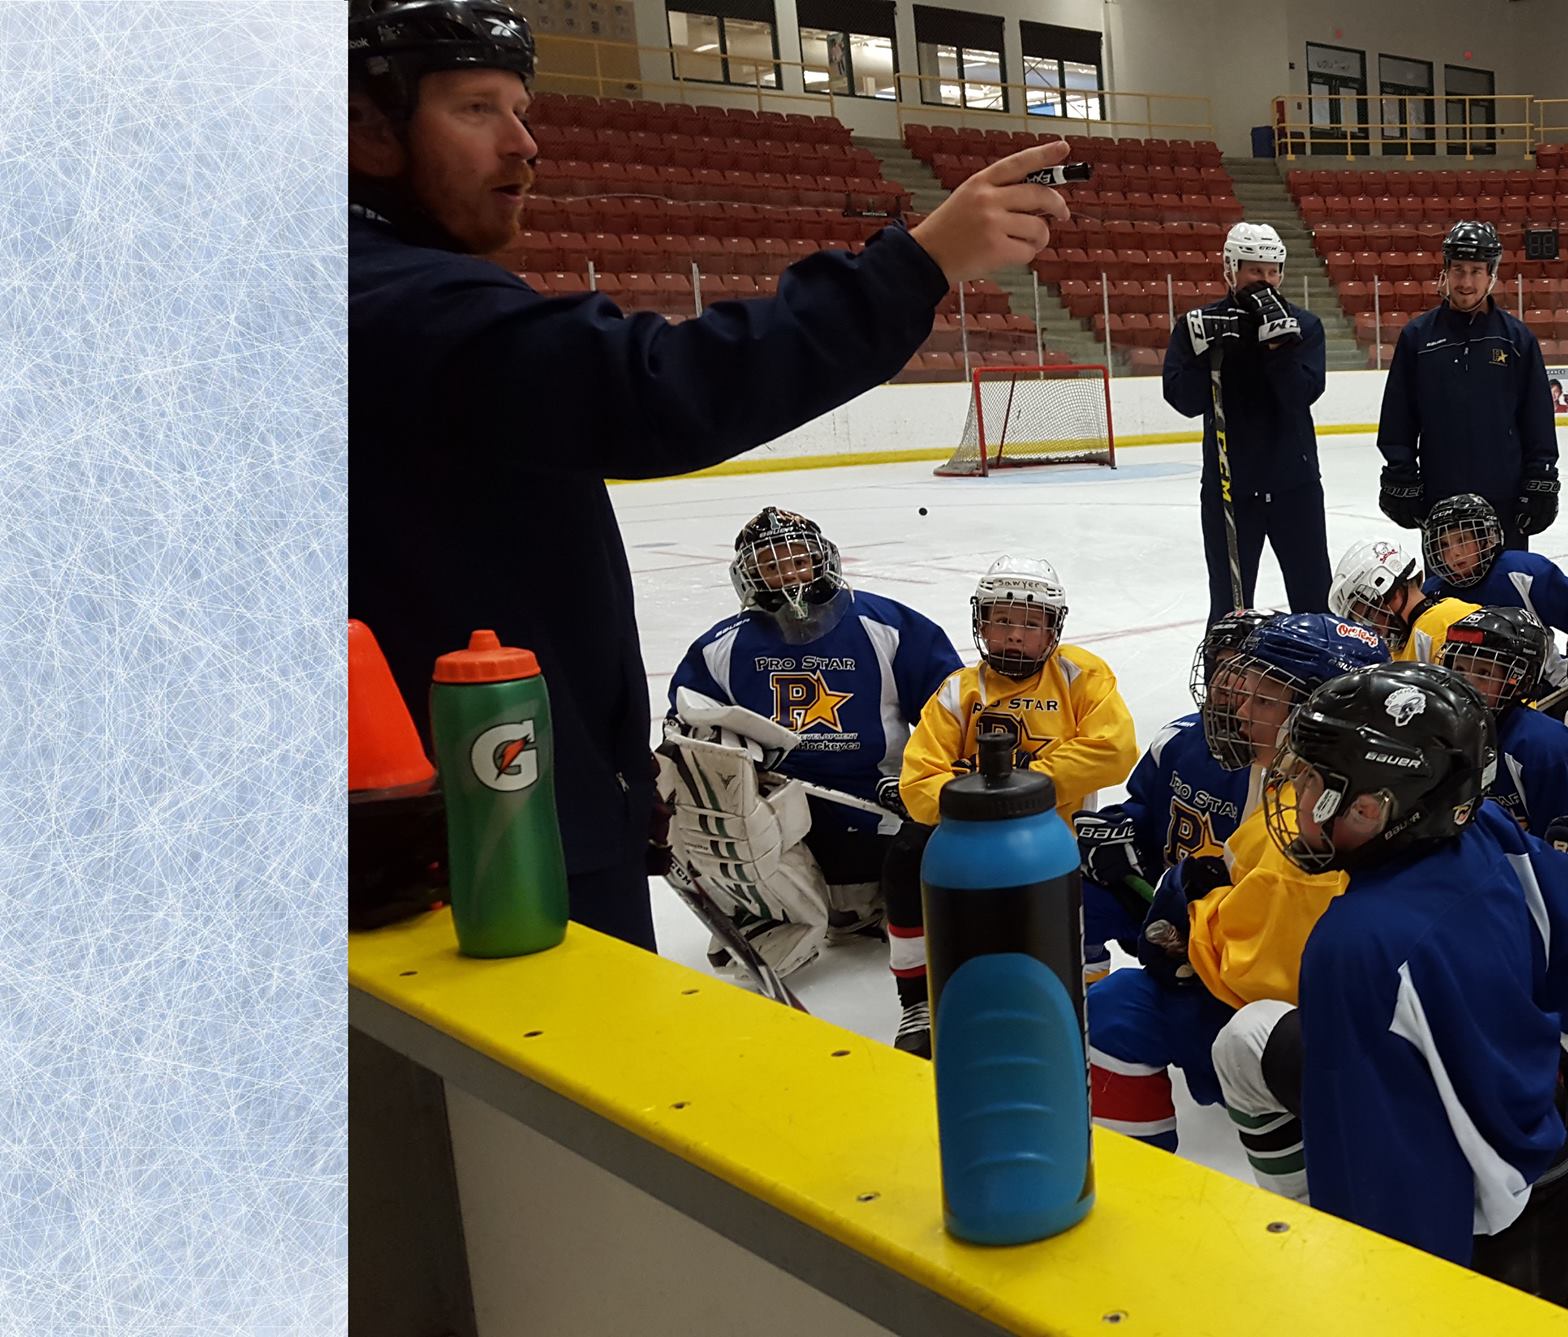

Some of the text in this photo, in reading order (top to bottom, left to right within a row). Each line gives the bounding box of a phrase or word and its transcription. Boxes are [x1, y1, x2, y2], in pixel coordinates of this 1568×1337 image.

[1432, 509, 1453, 520] CCM
[755, 656, 856, 671] PRO STAR
[1008, 698, 1059, 711] STAR
[470, 718, 539, 793] G
[1365, 752, 1422, 769] BAUER
[1193, 789, 1238, 819] STA
